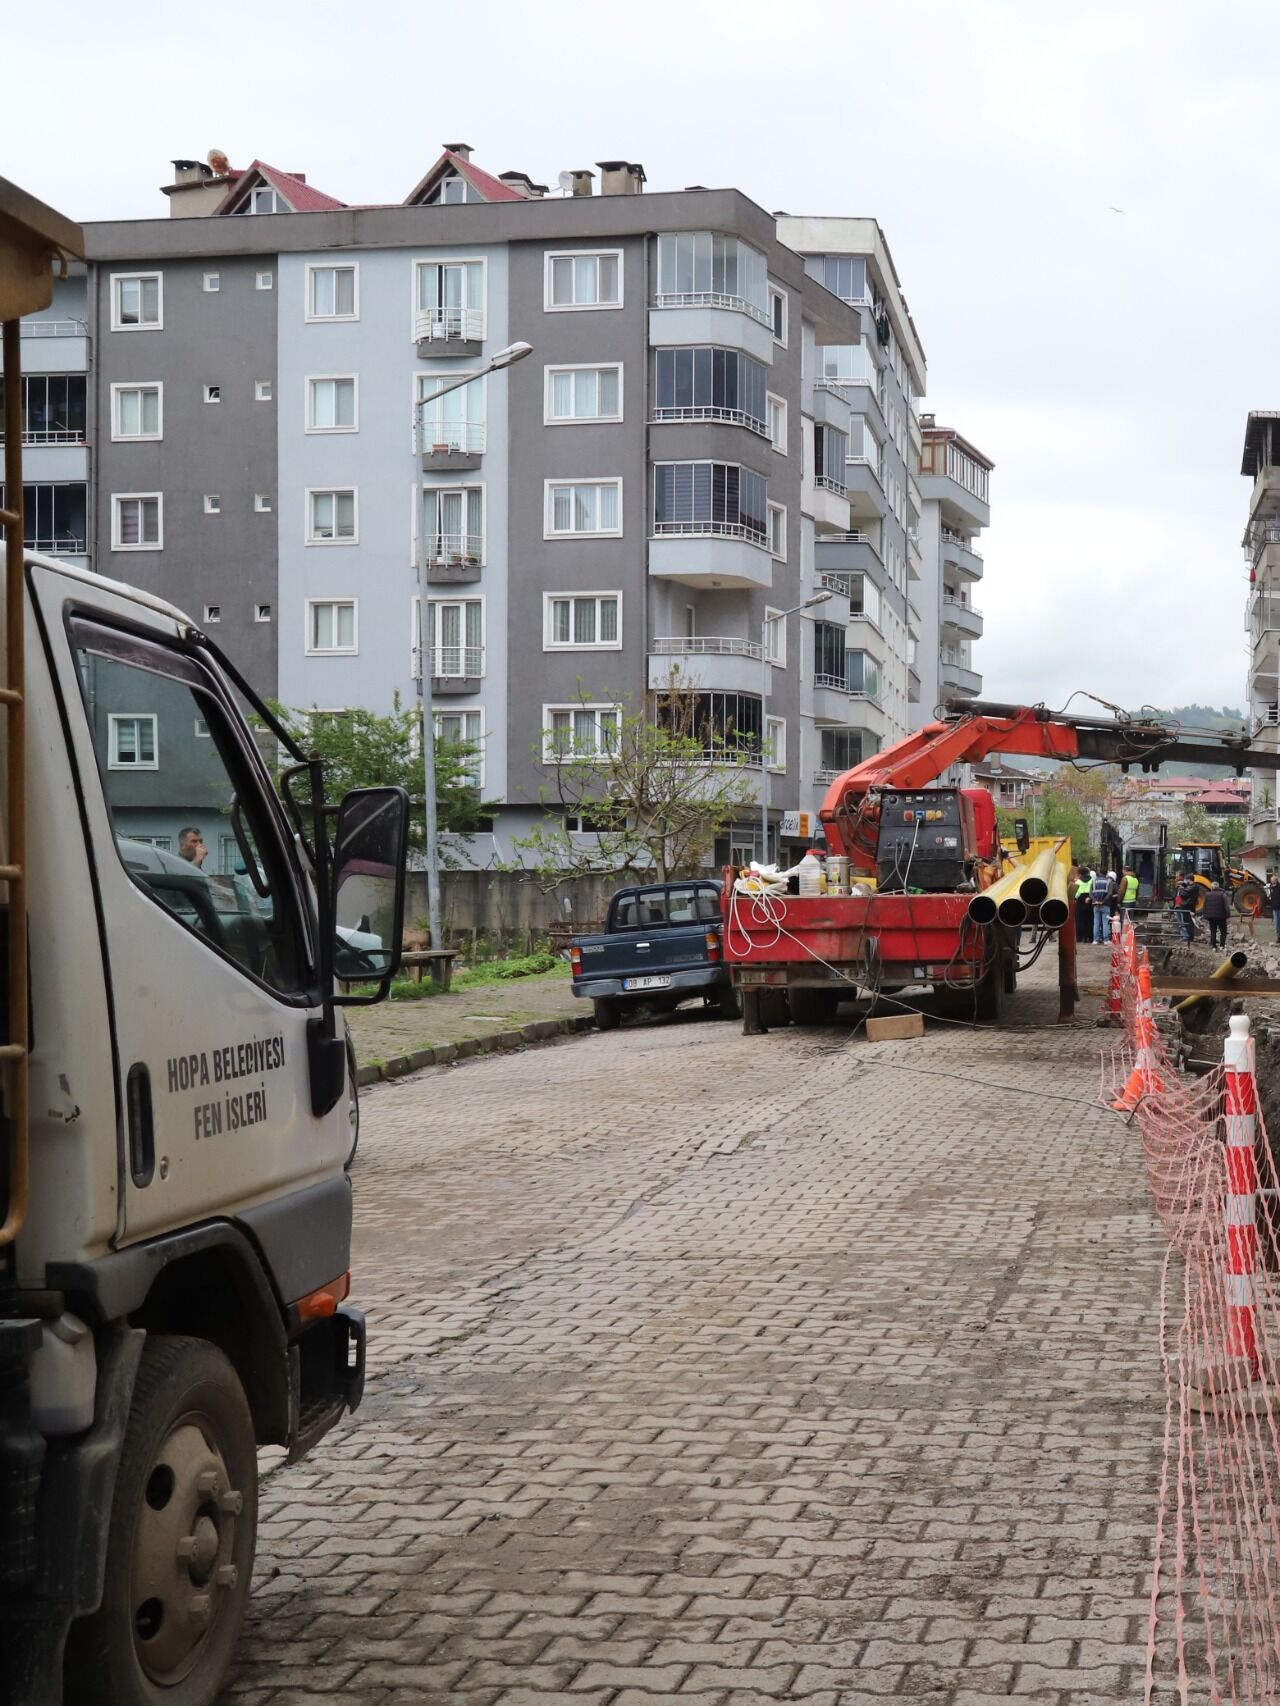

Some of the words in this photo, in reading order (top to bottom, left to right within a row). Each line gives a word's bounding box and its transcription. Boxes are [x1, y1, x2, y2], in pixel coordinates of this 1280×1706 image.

[643, 977, 652, 986] AP
[658, 976, 670, 984] 132
[167, 1052, 210, 1093] HOPA
[213, 1030, 285, 1081] BELEDİYESİ
[194, 1102, 223, 1141] FEN
[225, 1081, 267, 1134] İŞLERİ
